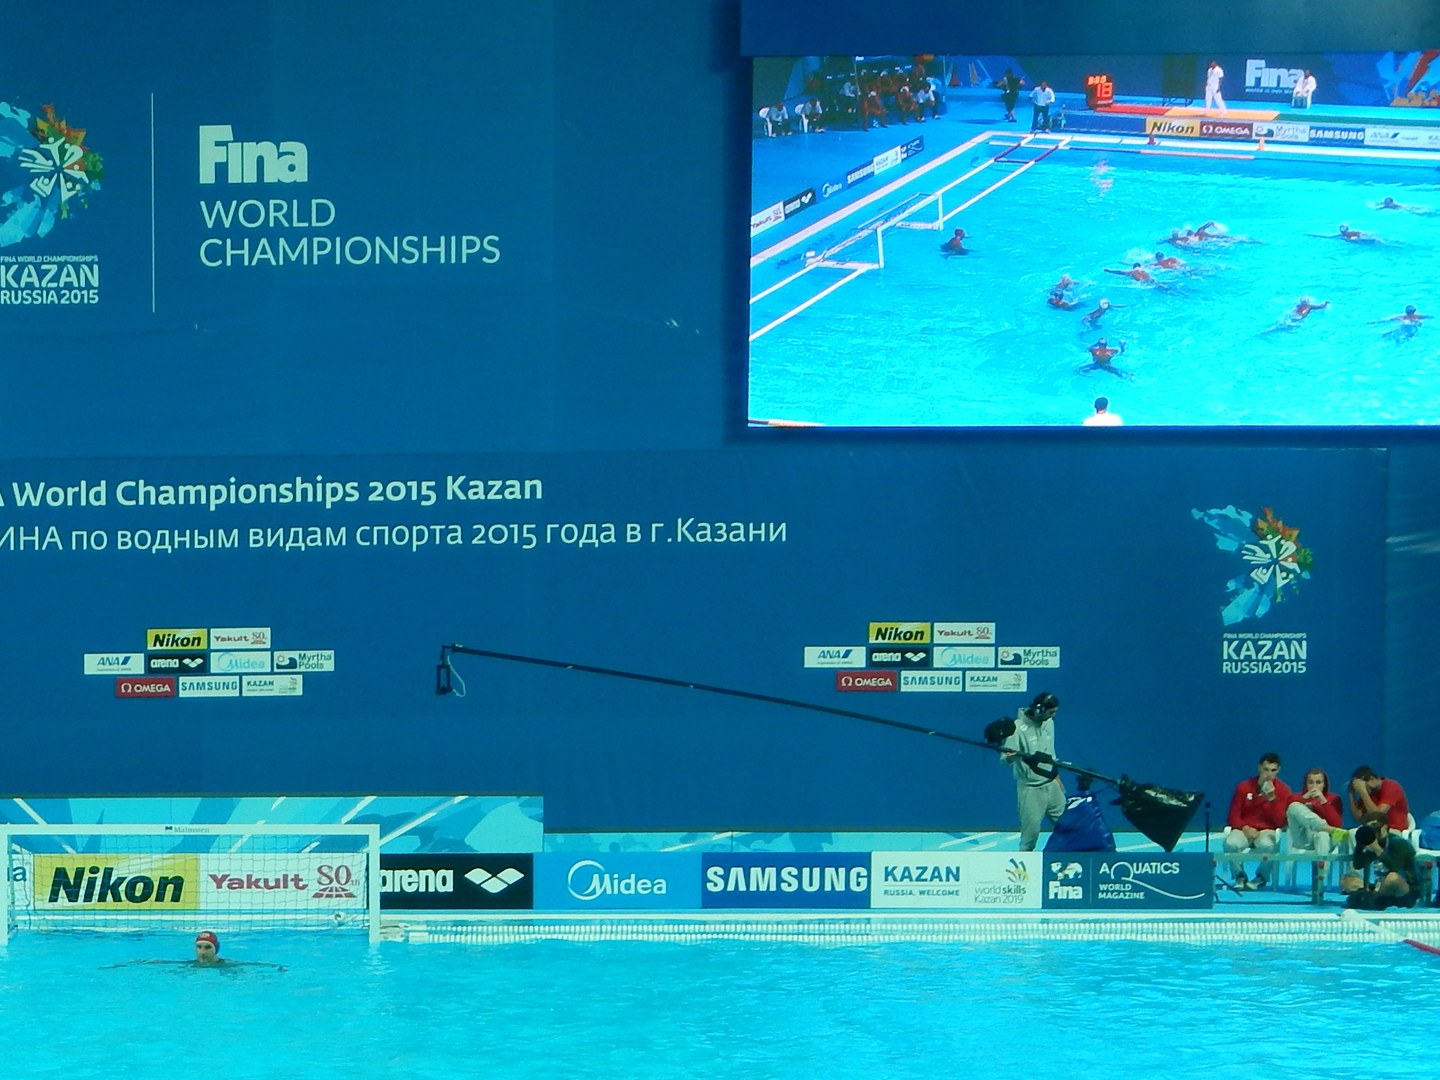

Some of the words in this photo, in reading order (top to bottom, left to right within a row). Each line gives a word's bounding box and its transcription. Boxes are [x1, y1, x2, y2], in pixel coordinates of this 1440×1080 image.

[1246, 59, 1304, 89] Fina
[1151, 122, 1195, 136] Nikon
[1214, 126, 1250, 136] OMEGA
[1310, 129, 1365, 140] SAMSUNG
[199, 124, 309, 184] Fina
[199, 198, 336, 229] WORLD
[199, 235, 501, 268] CHAMPIONSHIPS
[0, 255, 16, 263] FINA
[17, 255, 42, 263] WORLD
[43, 254, 99, 263] CHAMPIONSHIPS
[0, 264, 99, 288] KAZAN
[0, 290, 59, 304] RUSSIA
[60, 289, 99, 304] 2015
[12, 480, 106, 507] World
[116, 475, 359, 511] Championships
[368, 480, 436, 507] 2015
[446, 475, 543, 501] Kazan
[71, 529, 108, 551] по
[117, 527, 239, 554] водным
[248, 526, 346, 552] видам
[356, 524, 463, 551] спорта
[471, 523, 537, 549] 2015
[545, 522, 617, 548] года
[626, 522, 641, 543] в
[875, 627, 925, 641] Nikon
[938, 629, 974, 637] Yakult
[153, 633, 202, 648] Nikon
[818, 650, 842, 659] ANA
[1023, 649, 1058, 660] Myrtha
[1222, 640, 1307, 660] KAZAN
[97, 656, 121, 666] ANA
[150, 658, 179, 668] arena
[299, 652, 332, 663] Myrtha
[872, 652, 901, 662] arena
[1023, 657, 1049, 666] Pools
[298, 661, 324, 670] Pools
[1222, 661, 1272, 674] RUSSIA
[1273, 661, 1307, 674] 2015
[855, 677, 892, 687] OMEGA
[903, 676, 961, 686] SAMSUNG
[970, 675, 998, 683] KAZAN
[134, 683, 171, 693] OMEGA
[181, 681, 238, 691] SAMSUNG
[884, 866, 960, 883] KAZAN
[1099, 861, 1180, 881] AQUATICS
[48, 866, 185, 904] Nikon
[209, 873, 309, 891] Yakult
[380, 869, 453, 893] arena
[580, 868, 667, 898] Midea
[706, 866, 868, 893] SAMSUNG
[919, 888, 960, 897] WELCOME
[1049, 881, 1083, 900] Fina
[975, 894, 1001, 904] Kazan
[1003, 894, 1024, 904] 2019
